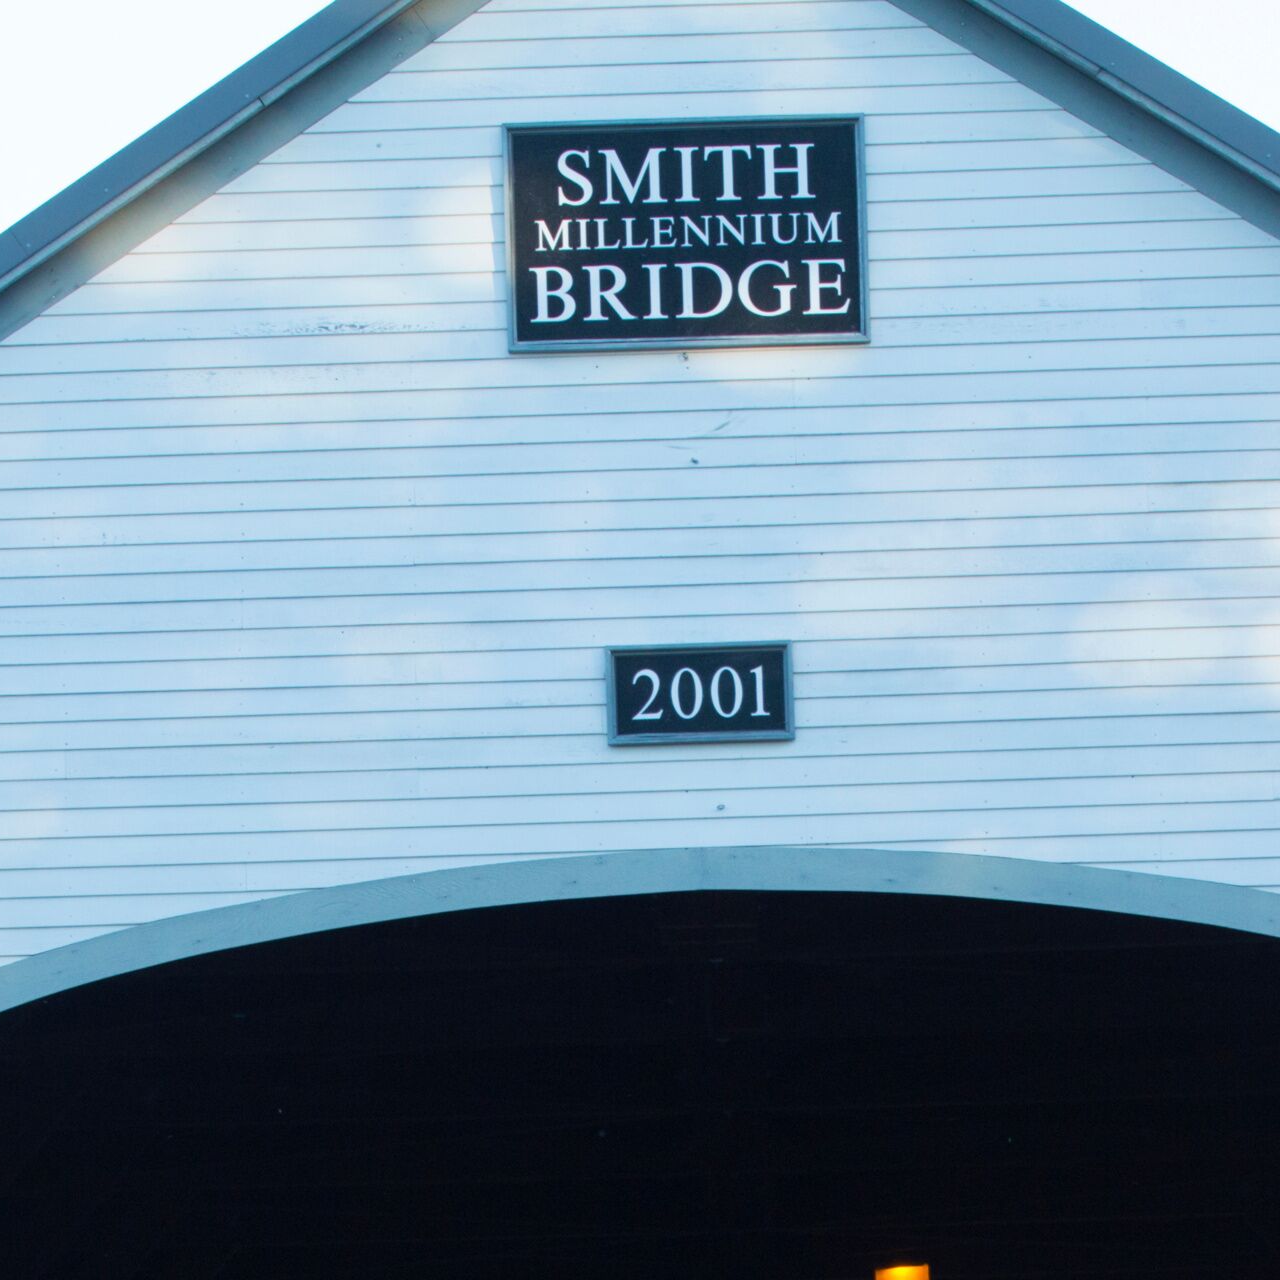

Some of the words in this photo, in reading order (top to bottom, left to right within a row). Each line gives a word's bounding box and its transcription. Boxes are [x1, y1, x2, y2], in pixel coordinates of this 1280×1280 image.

[557, 143, 816, 207] SMITH
[533, 211, 843, 252] MILLENNIUM
[528, 258, 851, 324] BRIDGE
[631, 664, 771, 721] 2001
